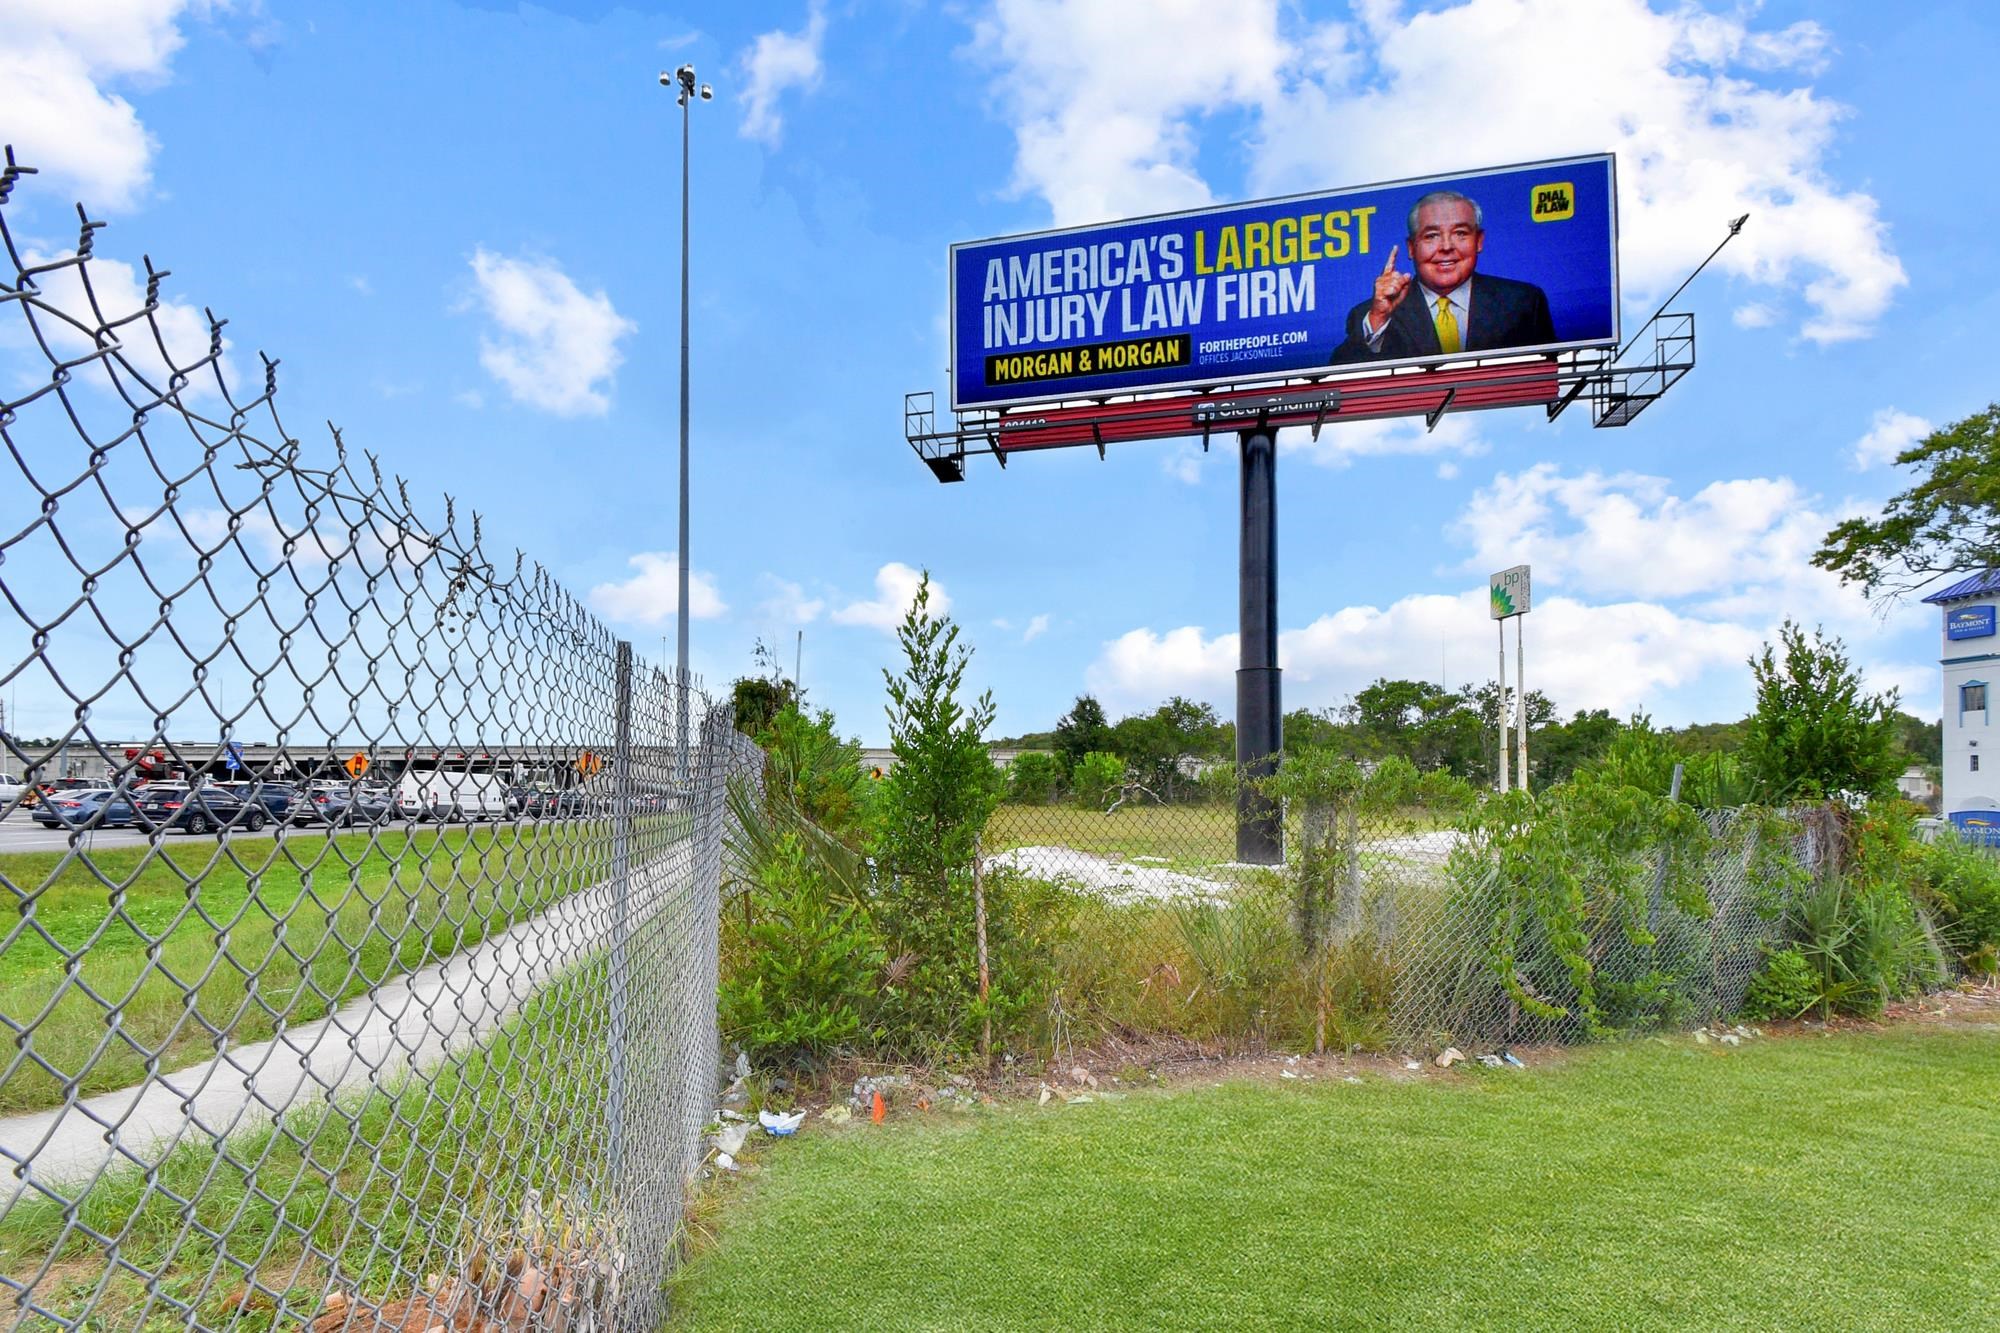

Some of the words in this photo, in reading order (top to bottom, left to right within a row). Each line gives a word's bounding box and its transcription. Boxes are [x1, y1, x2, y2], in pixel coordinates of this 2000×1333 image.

[1538, 190, 1566, 202] DIAL
[1535, 200, 1569, 214] #LAW
[983, 233, 1184, 303] AMERICA'S
[1195, 206, 1376, 275] LARGEST
[983, 291, 1111, 349] INJURY
[1122, 279, 1206, 333] LAW
[1217, 265, 1316, 322] FIRM
[1199, 331, 1308, 354] FORTHEPEOPLE.COM
[995, 351, 1072, 381] MORGAN
[1079, 350, 1092, 372] &
[1098, 340, 1180, 369] MORGAN
[1199, 352, 1230, 366] OFFICES
[1230, 347, 1284, 363] JACKSONVILLE
[1267, 392, 1334, 412] Channl
[1504, 572, 1519, 587] bp
[1950, 618, 1991, 630] BAYMONT
